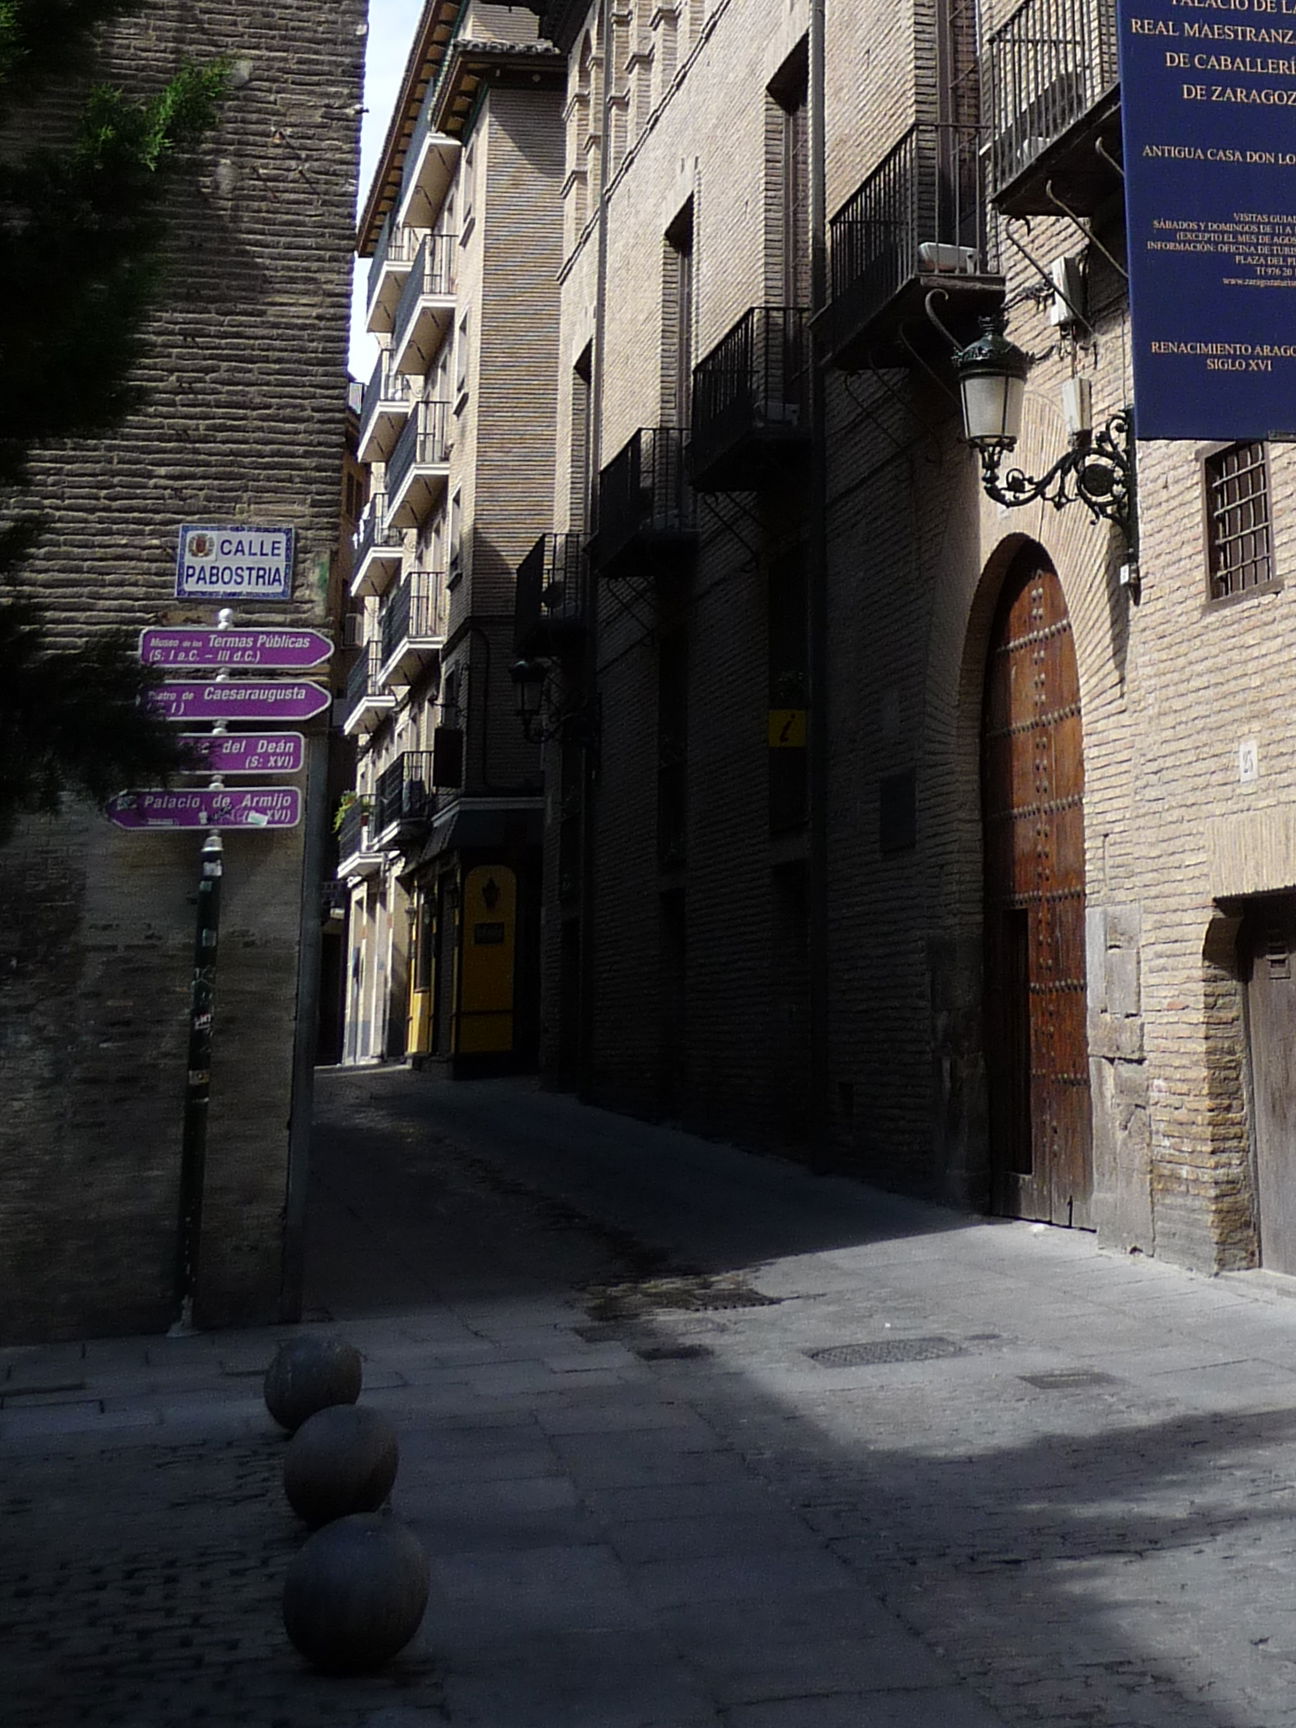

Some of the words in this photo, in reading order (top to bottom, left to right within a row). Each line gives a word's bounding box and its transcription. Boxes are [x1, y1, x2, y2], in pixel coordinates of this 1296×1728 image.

[1131, 19, 1179, 36] REAL
[1166, 52, 1190, 67] DE
[1183, 84, 1207, 100] DE
[1142, 145, 1202, 160] ANTIGUA
[1207, 149, 1242, 162] CASA
[1246, 151, 1275, 164] DON
[1233, 212, 1268, 222] VISITAS
[1153, 218, 1197, 230] SÁBADOS
[1199, 222, 1206, 230] Y
[1208, 222, 1258, 233] DOMINGOS
[1260, 225, 1273, 233] DE
[1275, 225, 1283, 234] 11
[1284, 226, 1292, 234] A
[1176, 231, 1222, 241] (EXCEPTO
[1224, 233, 1236, 242] EL
[1237, 234, 1256, 243] MES
[1259, 235, 1272, 243] DE
[1218, 244, 1256, 253] OFICINA
[1258, 246, 1272, 254] DE
[1235, 255, 1265, 265] PLAZA
[1267, 256, 1286, 265] DEL
[1267, 267, 1281, 276] 976
[1282, 268, 1293, 276] 20
[1151, 341, 1251, 355] RENACIMIENTO
[1206, 359, 1245, 371] SIGLO
[1249, 360, 1272, 371] XVI
[220, 539, 282, 556] CALLE
[185, 565, 284, 586] PABOSTRIA
[150, 638, 179, 647] Museo
[208, 635, 253, 648] Termas
[257, 635, 310, 648] Públicas
[149, 650, 166, 661] (S:
[169, 650, 175, 660] I
[177, 650, 200, 661] a.C.
[217, 651, 230, 661] III
[233, 651, 261, 663] d.C.)
[182, 691, 194, 700] de
[204, 688, 306, 702] Caesaraugusta
[222, 741, 246, 753] del
[257, 740, 294, 753] Deán
[245, 756, 263, 768] (S:
[267, 756, 294, 768] XVI)
[144, 796, 200, 808] Palacio
[212, 795, 231, 808] de
[242, 794, 292, 810] Armijo
